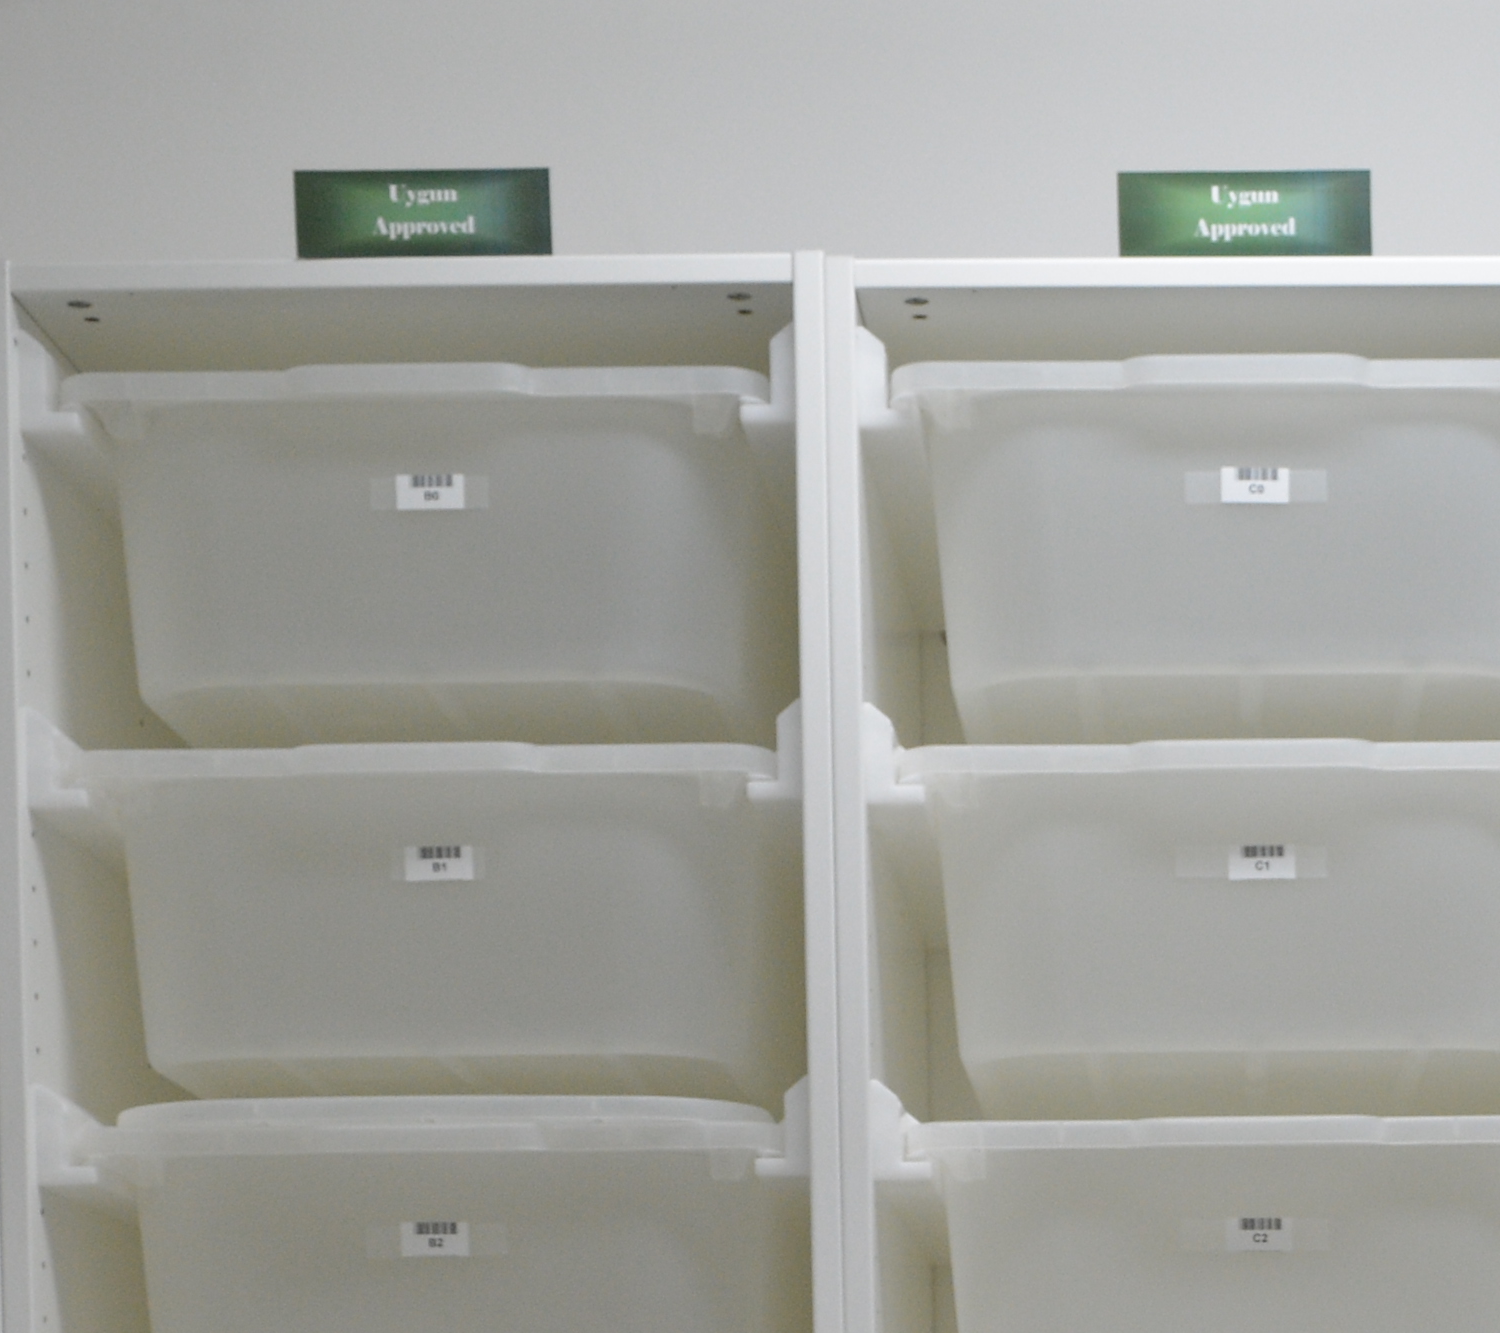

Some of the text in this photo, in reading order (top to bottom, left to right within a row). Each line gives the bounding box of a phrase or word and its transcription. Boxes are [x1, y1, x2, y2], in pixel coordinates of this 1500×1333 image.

[388, 184, 458, 204] Uygun
[1210, 185, 1279, 208] Uygun
[373, 215, 476, 240] Approved
[1195, 217, 1296, 242] Approved
[1247, 483, 1266, 495] C0
[423, 490, 440, 502] B0
[431, 861, 448, 873] B1
[1254, 859, 1271, 872] C1
[427, 1237, 444, 1249] B2
[1252, 1232, 1269, 1244] C2
